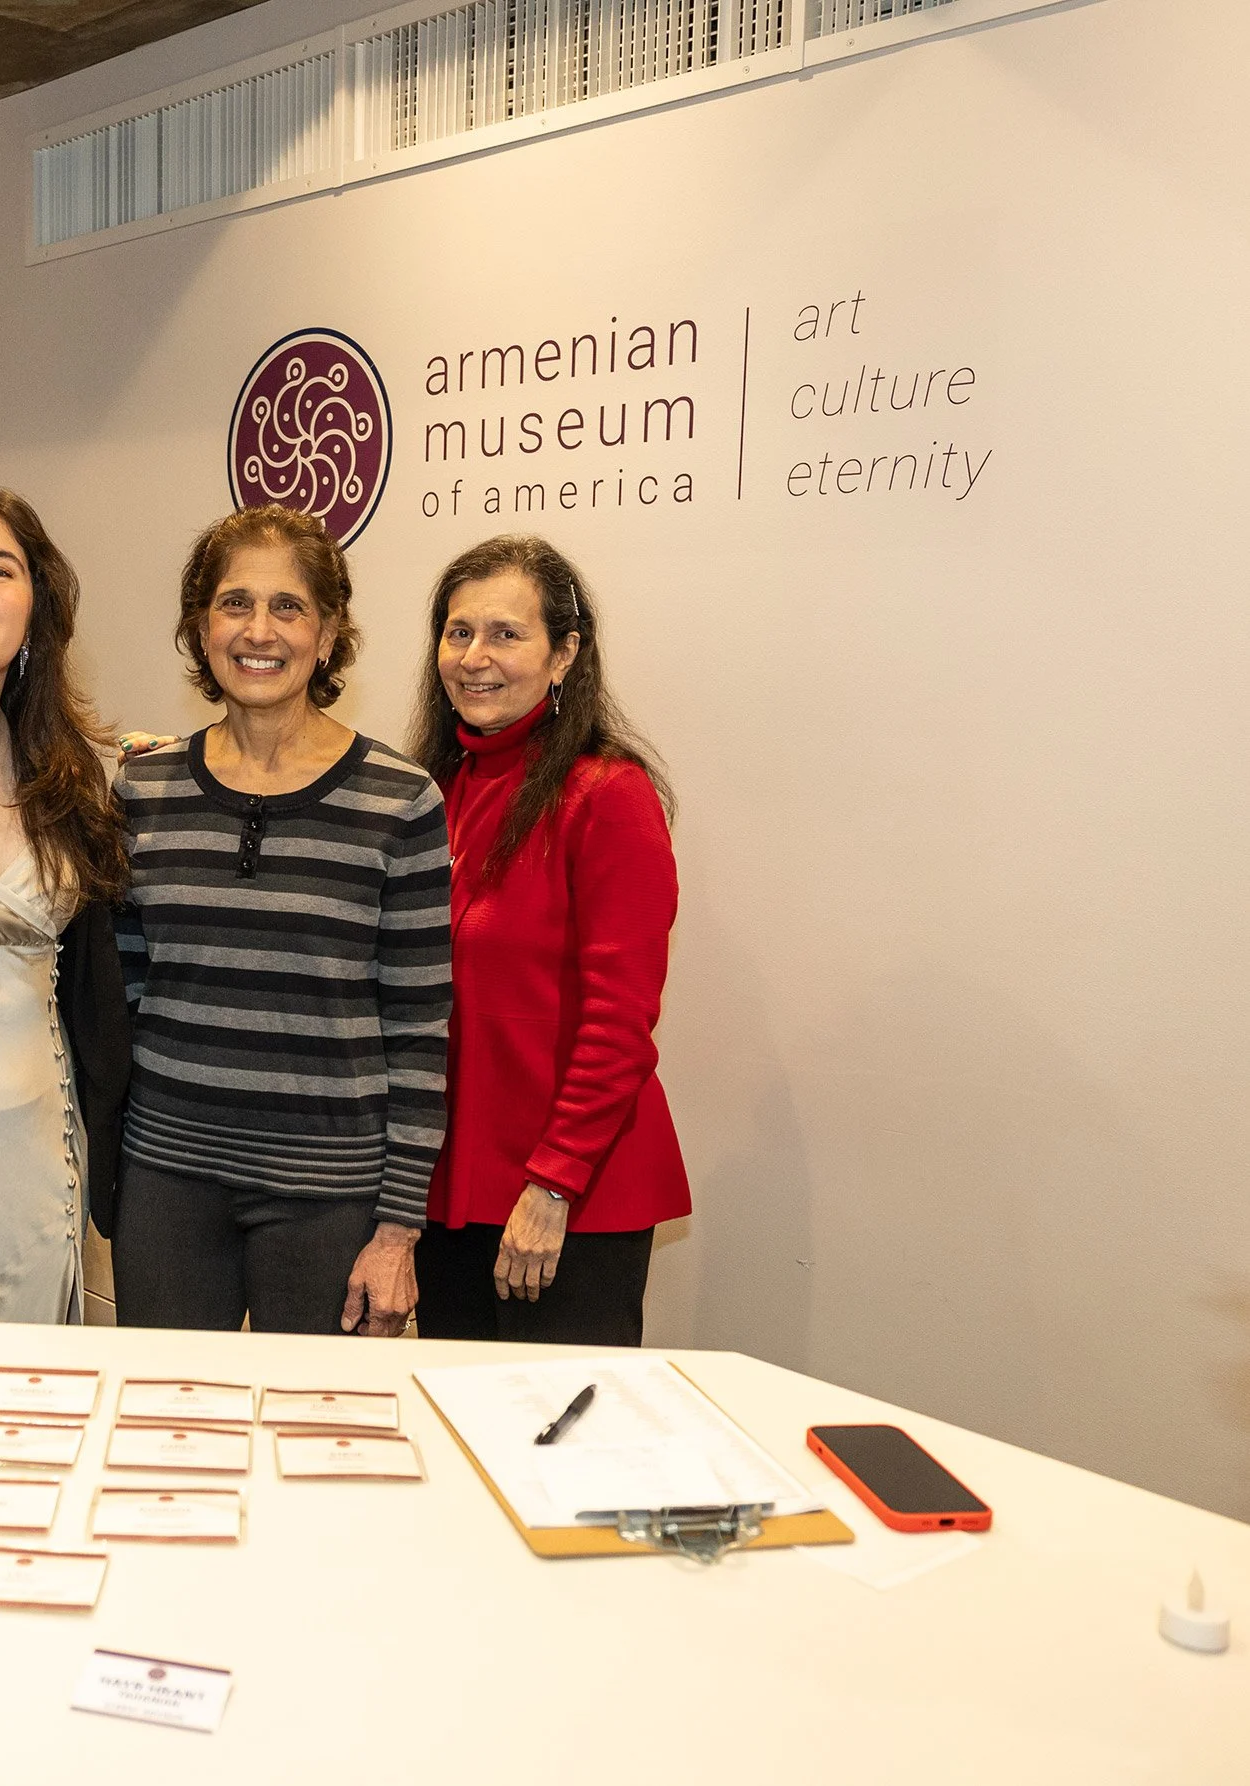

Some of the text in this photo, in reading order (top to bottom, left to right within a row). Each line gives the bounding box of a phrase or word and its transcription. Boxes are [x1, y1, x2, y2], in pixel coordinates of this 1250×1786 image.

[793, 289, 866, 341] art
[425, 316, 697, 396] armenian
[790, 364, 976, 419] culture
[424, 396, 695, 462] museum
[422, 468, 693, 517] of america
[786, 440, 993, 501] eternity
